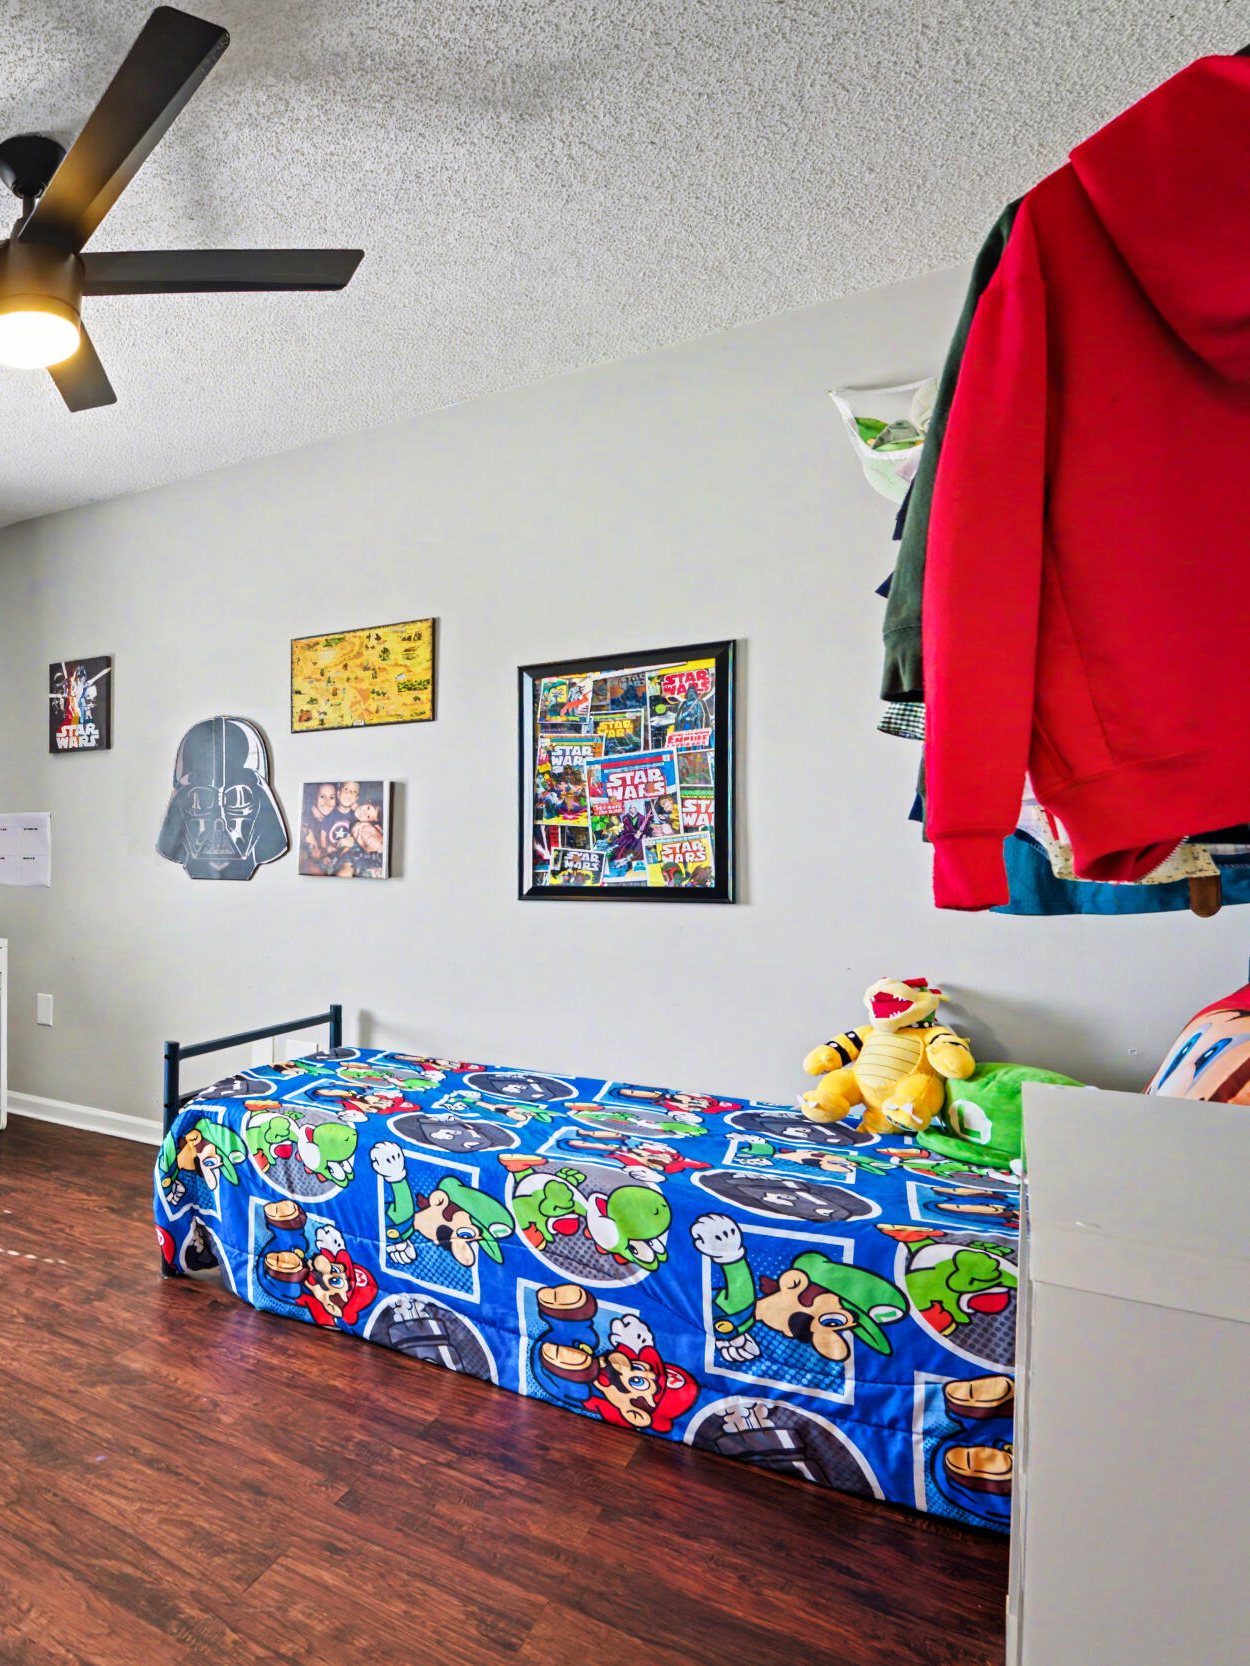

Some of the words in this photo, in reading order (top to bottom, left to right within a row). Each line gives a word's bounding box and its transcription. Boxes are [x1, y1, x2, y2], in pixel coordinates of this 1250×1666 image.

[662, 670, 710, 686] STAR
[56, 723, 99, 738] STAR
[597, 720, 633, 730] STAR
[56, 735, 99, 749] WARS
[551, 746, 593, 757] STAR
[607, 769, 664, 788] STAR
[661, 841, 706, 854] STAR
[662, 851, 706, 864] WARS
